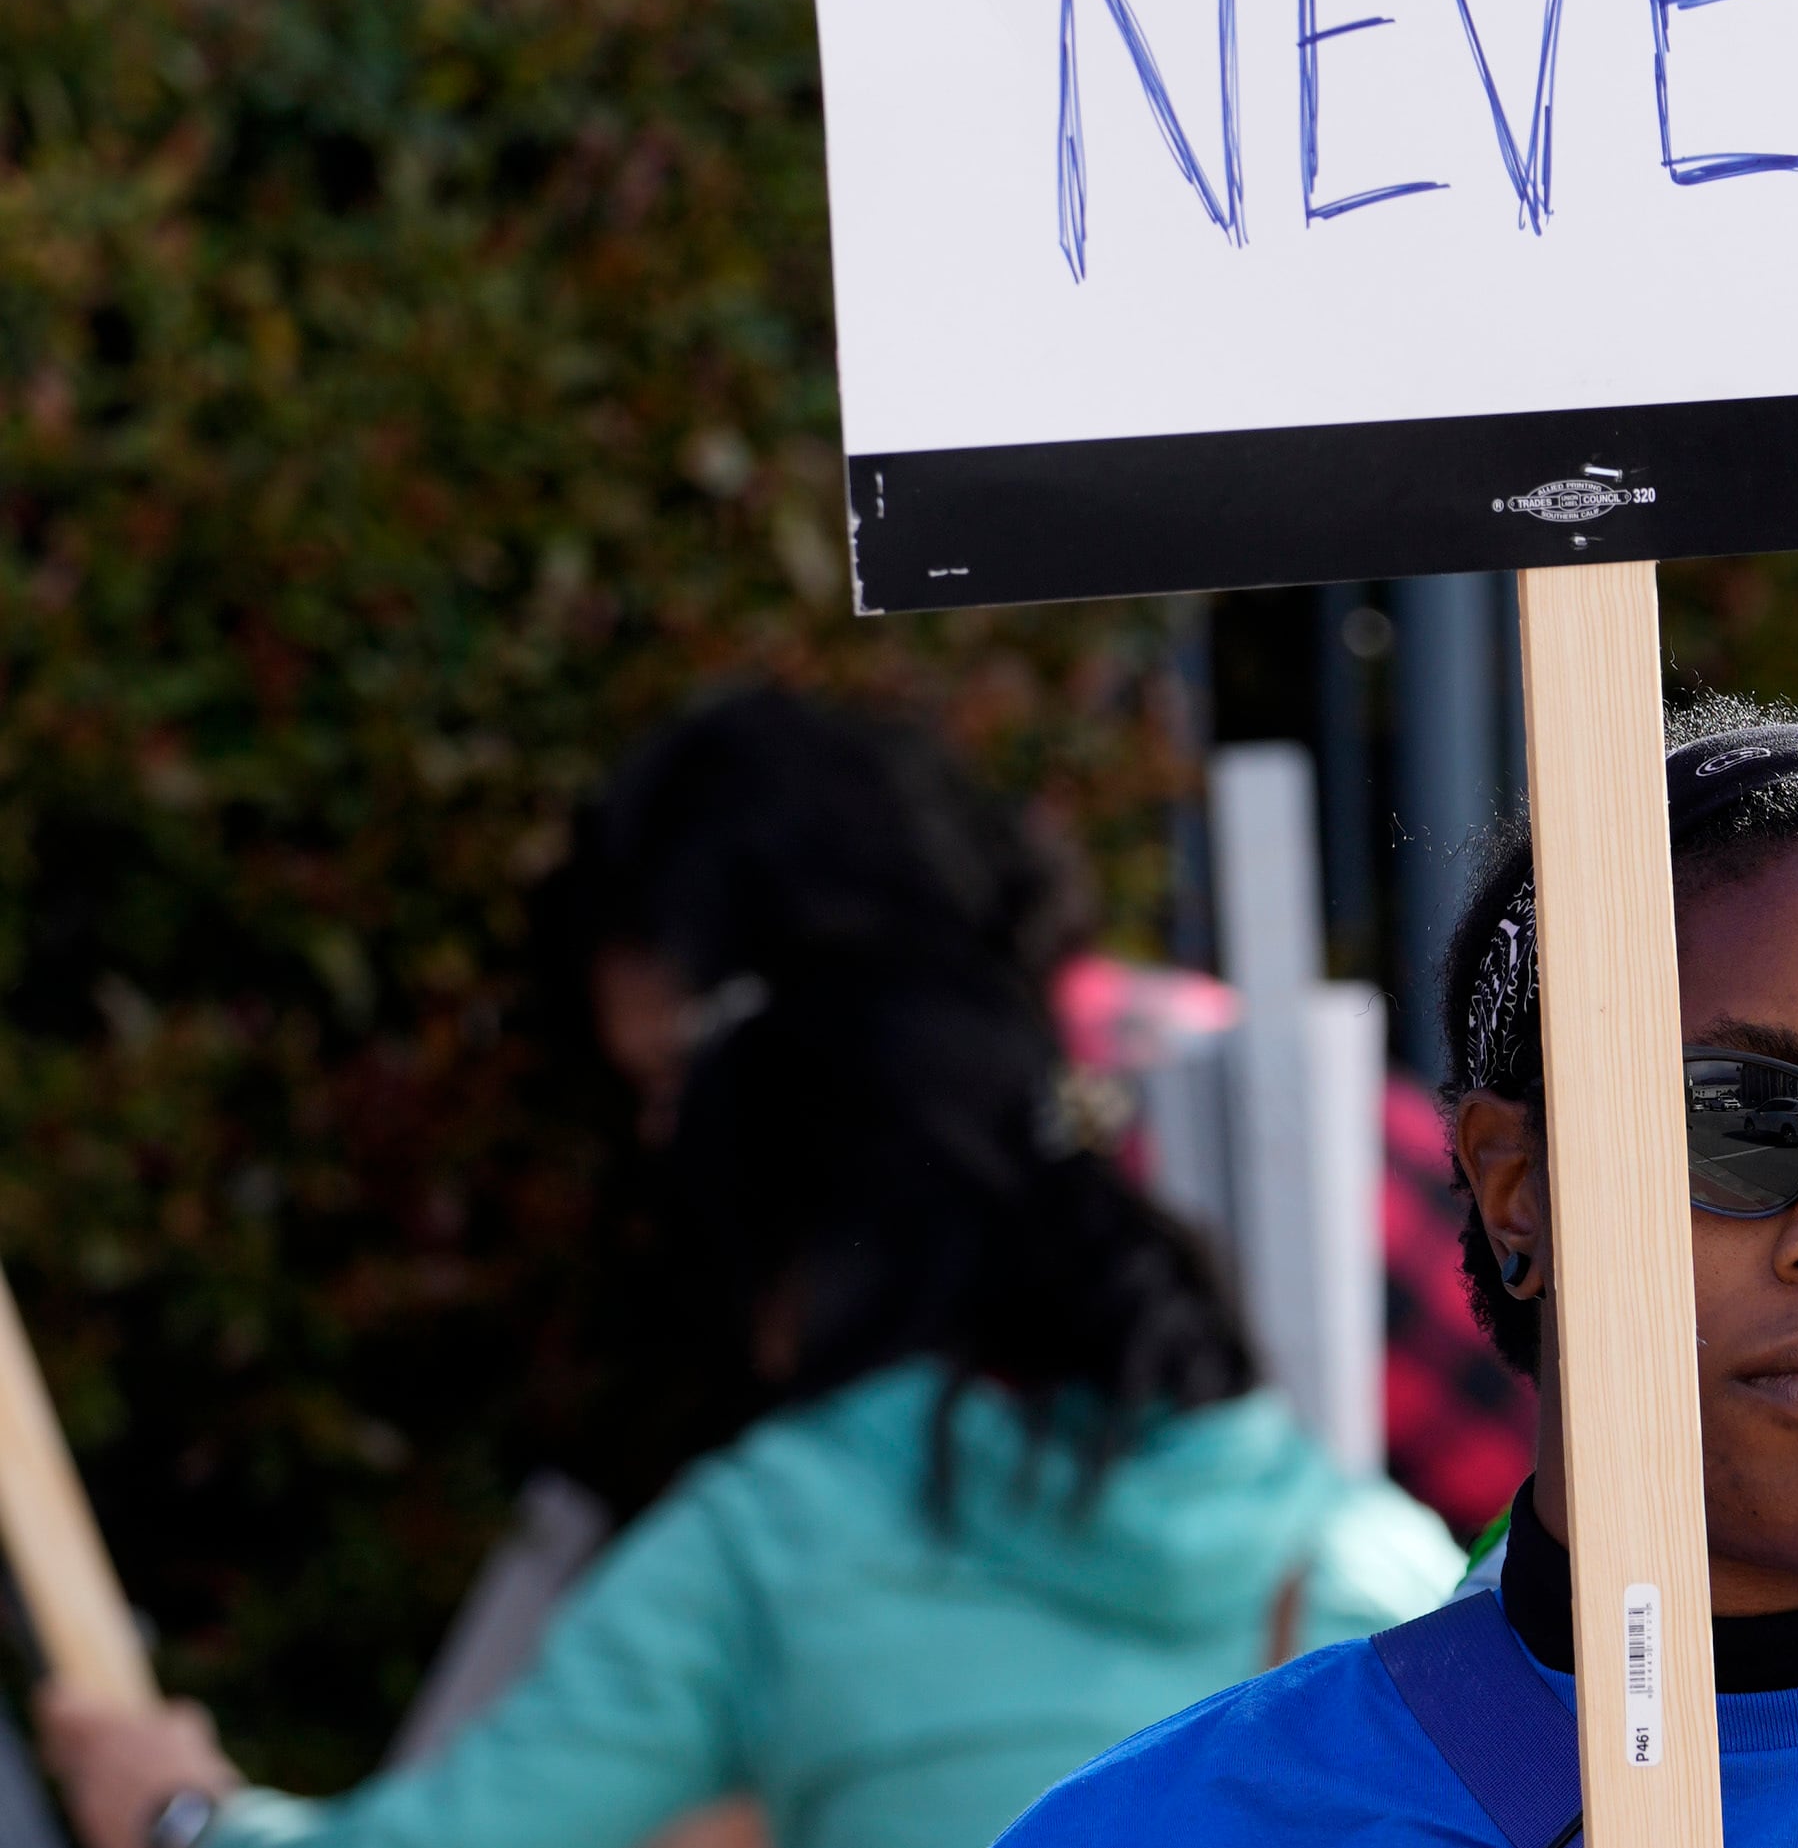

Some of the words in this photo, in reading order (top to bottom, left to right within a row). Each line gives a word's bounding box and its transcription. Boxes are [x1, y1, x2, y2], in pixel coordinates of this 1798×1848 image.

[1537, 483, 1564, 496] ALLIED
[1566, 482, 1602, 492] PRINTING
[1632, 487, 1656, 503] 320
[1517, 498, 1553, 508] TRADES
[1583, 493, 1621, 504] COUNCIL
[1541, 511, 1579, 520] SOUTHERN
[1635, 1727, 1650, 1762] P461
